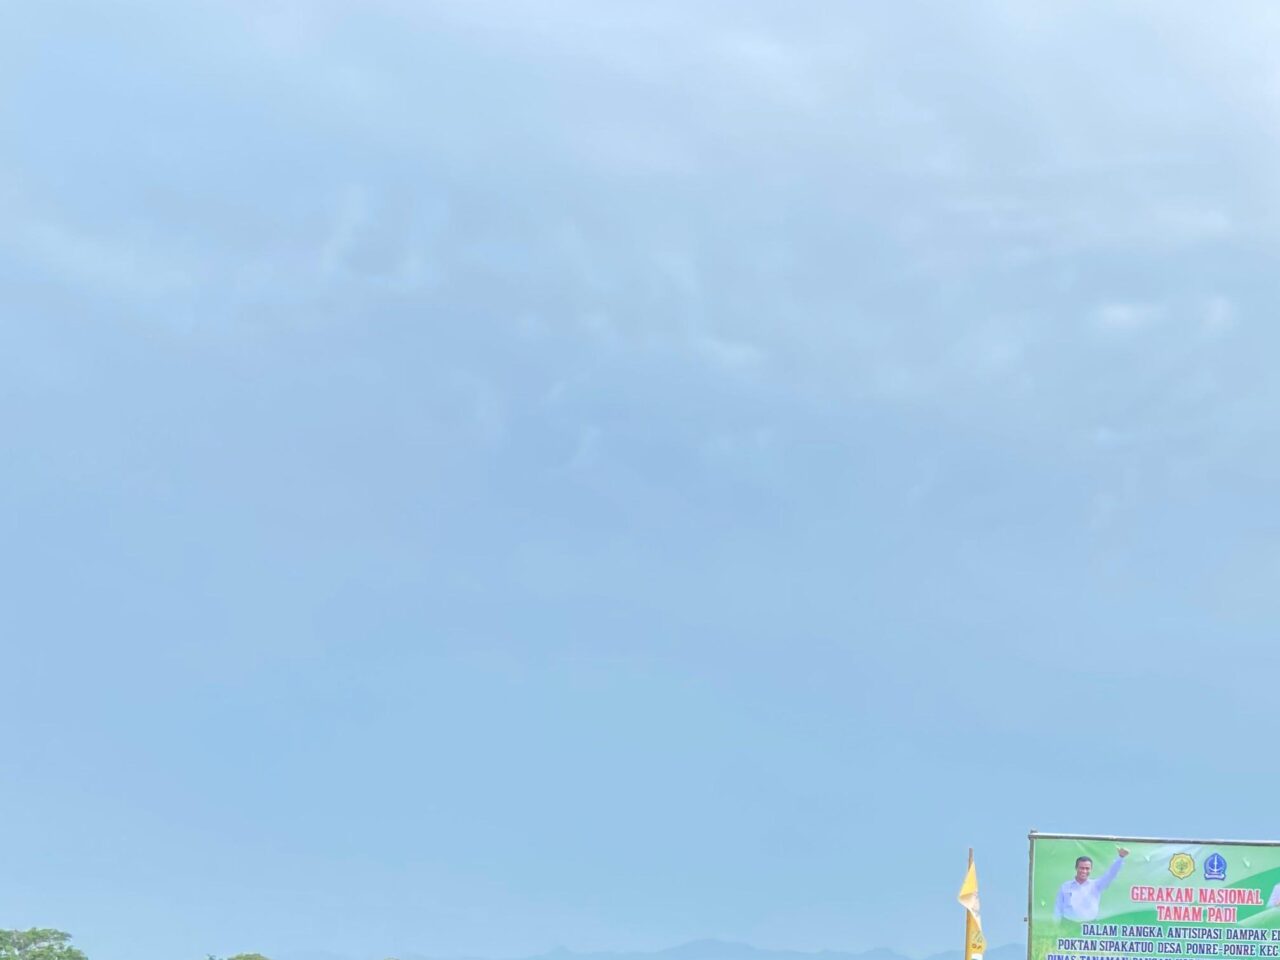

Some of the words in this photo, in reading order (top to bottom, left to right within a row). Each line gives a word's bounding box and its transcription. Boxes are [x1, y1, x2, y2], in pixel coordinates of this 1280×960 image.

[1131, 886, 1193, 902] GERAKAN
[1199, 888, 1263, 904] NASIONAL
[1157, 906, 1202, 921] TANAM
[1208, 907, 1236, 922] PADI
[1083, 925, 1117, 937] DALAM
[1122, 926, 1163, 938] RANGKA
[1167, 927, 1222, 939] ANTISIPASI
[1226, 929, 1267, 941] DAMPAK
[1058, 939, 1097, 951] POKTAN
[1100, 940, 1154, 953] SIPAKATUO
[1158, 942, 1182, 954] DESA
[1260, 945, 1279, 957] KEC
